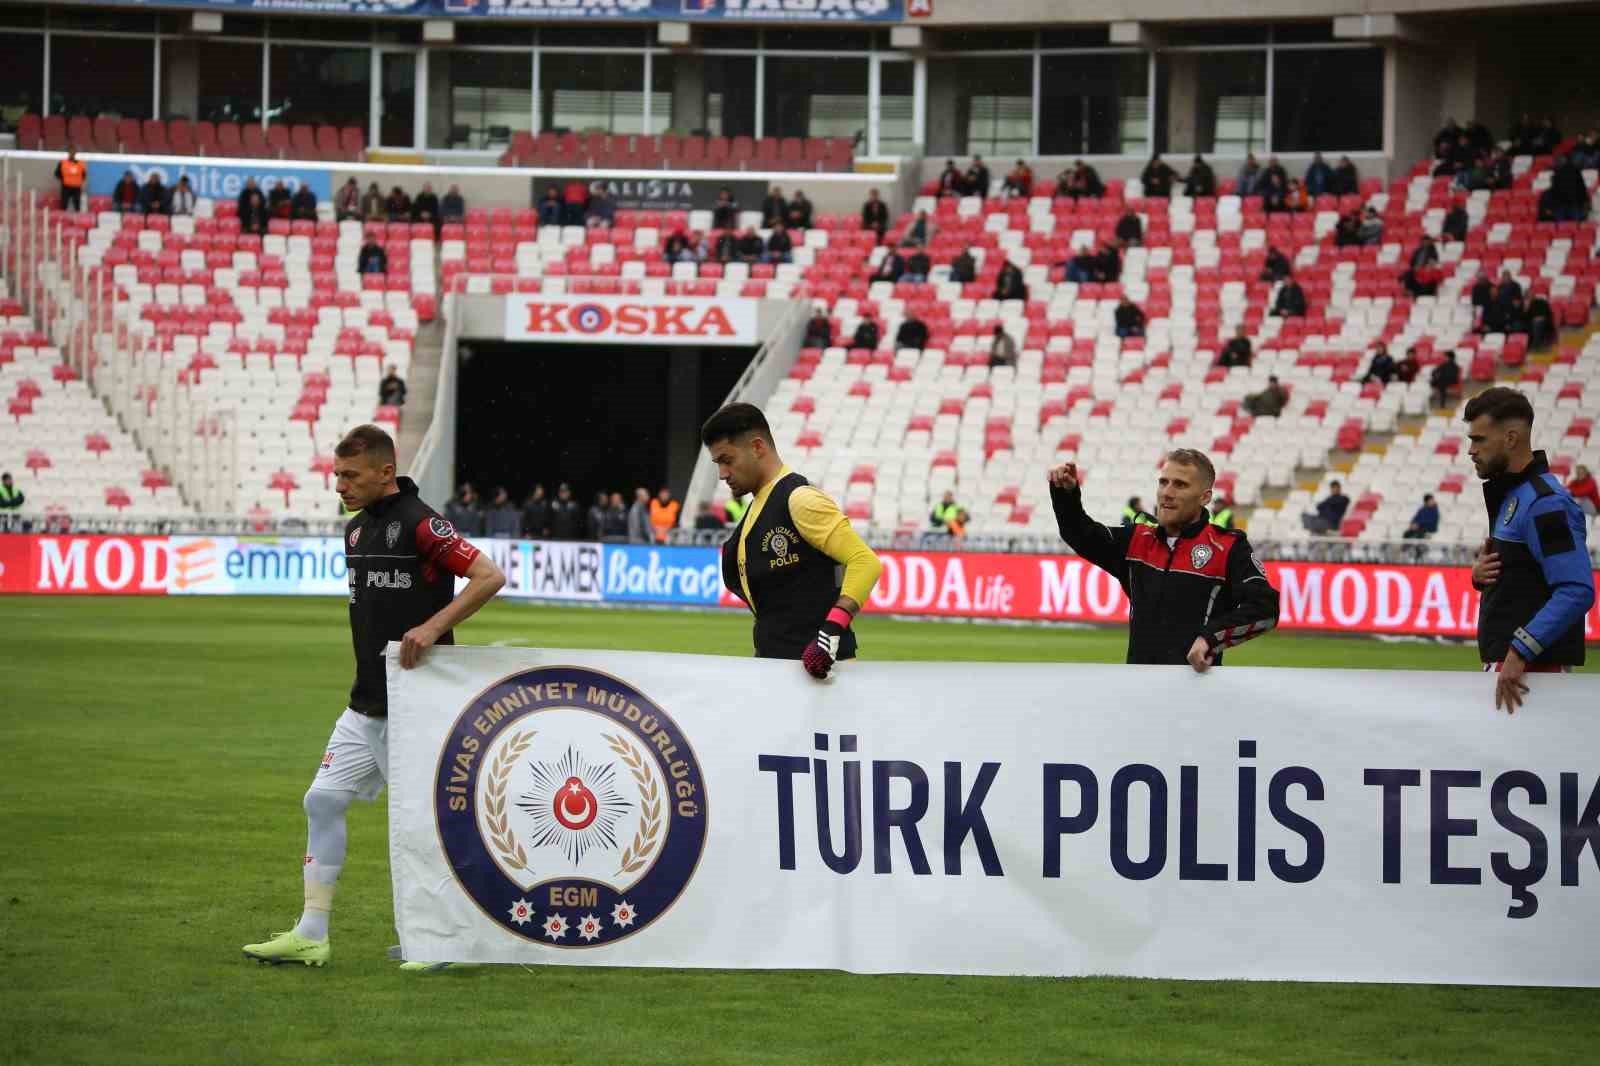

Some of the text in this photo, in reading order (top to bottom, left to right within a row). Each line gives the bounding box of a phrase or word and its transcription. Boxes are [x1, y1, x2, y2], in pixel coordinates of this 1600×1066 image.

[525, 302, 737, 336] KOSKA
[367, 569, 413, 589] POLİS
[1278, 567, 1456, 630] MODA
[445, 682, 699, 819] SİVAS EMNİYET MÜDÜRLÜĞÜ
[758, 732, 1600, 919] TÜRK POLİS TEŞK
[549, 886, 598, 908] EGM
